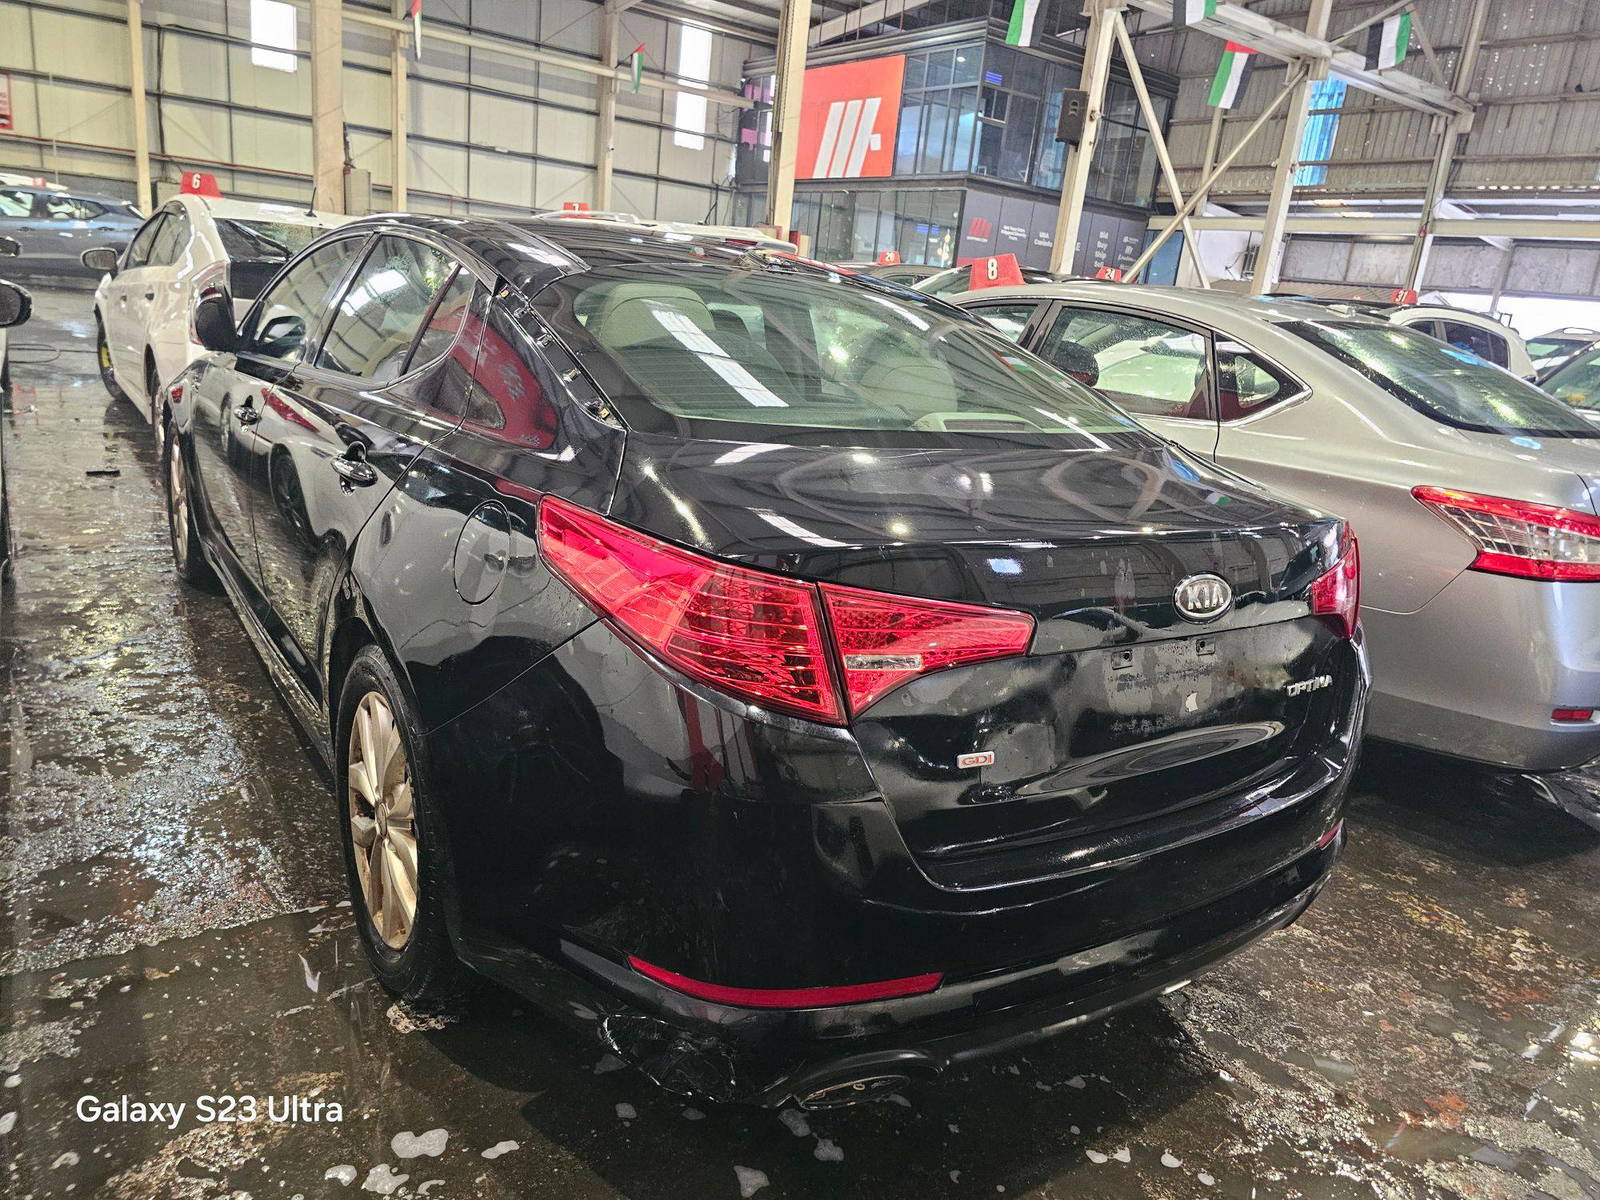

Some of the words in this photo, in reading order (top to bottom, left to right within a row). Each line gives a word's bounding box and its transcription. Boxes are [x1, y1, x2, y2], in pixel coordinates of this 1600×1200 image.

[192, 173, 201, 189] 6
[987, 258, 998, 280] 8
[1185, 583, 1224, 610] KIA
[1286, 675, 1333, 697] OPTIMA
[960, 754, 993, 767] GDI
